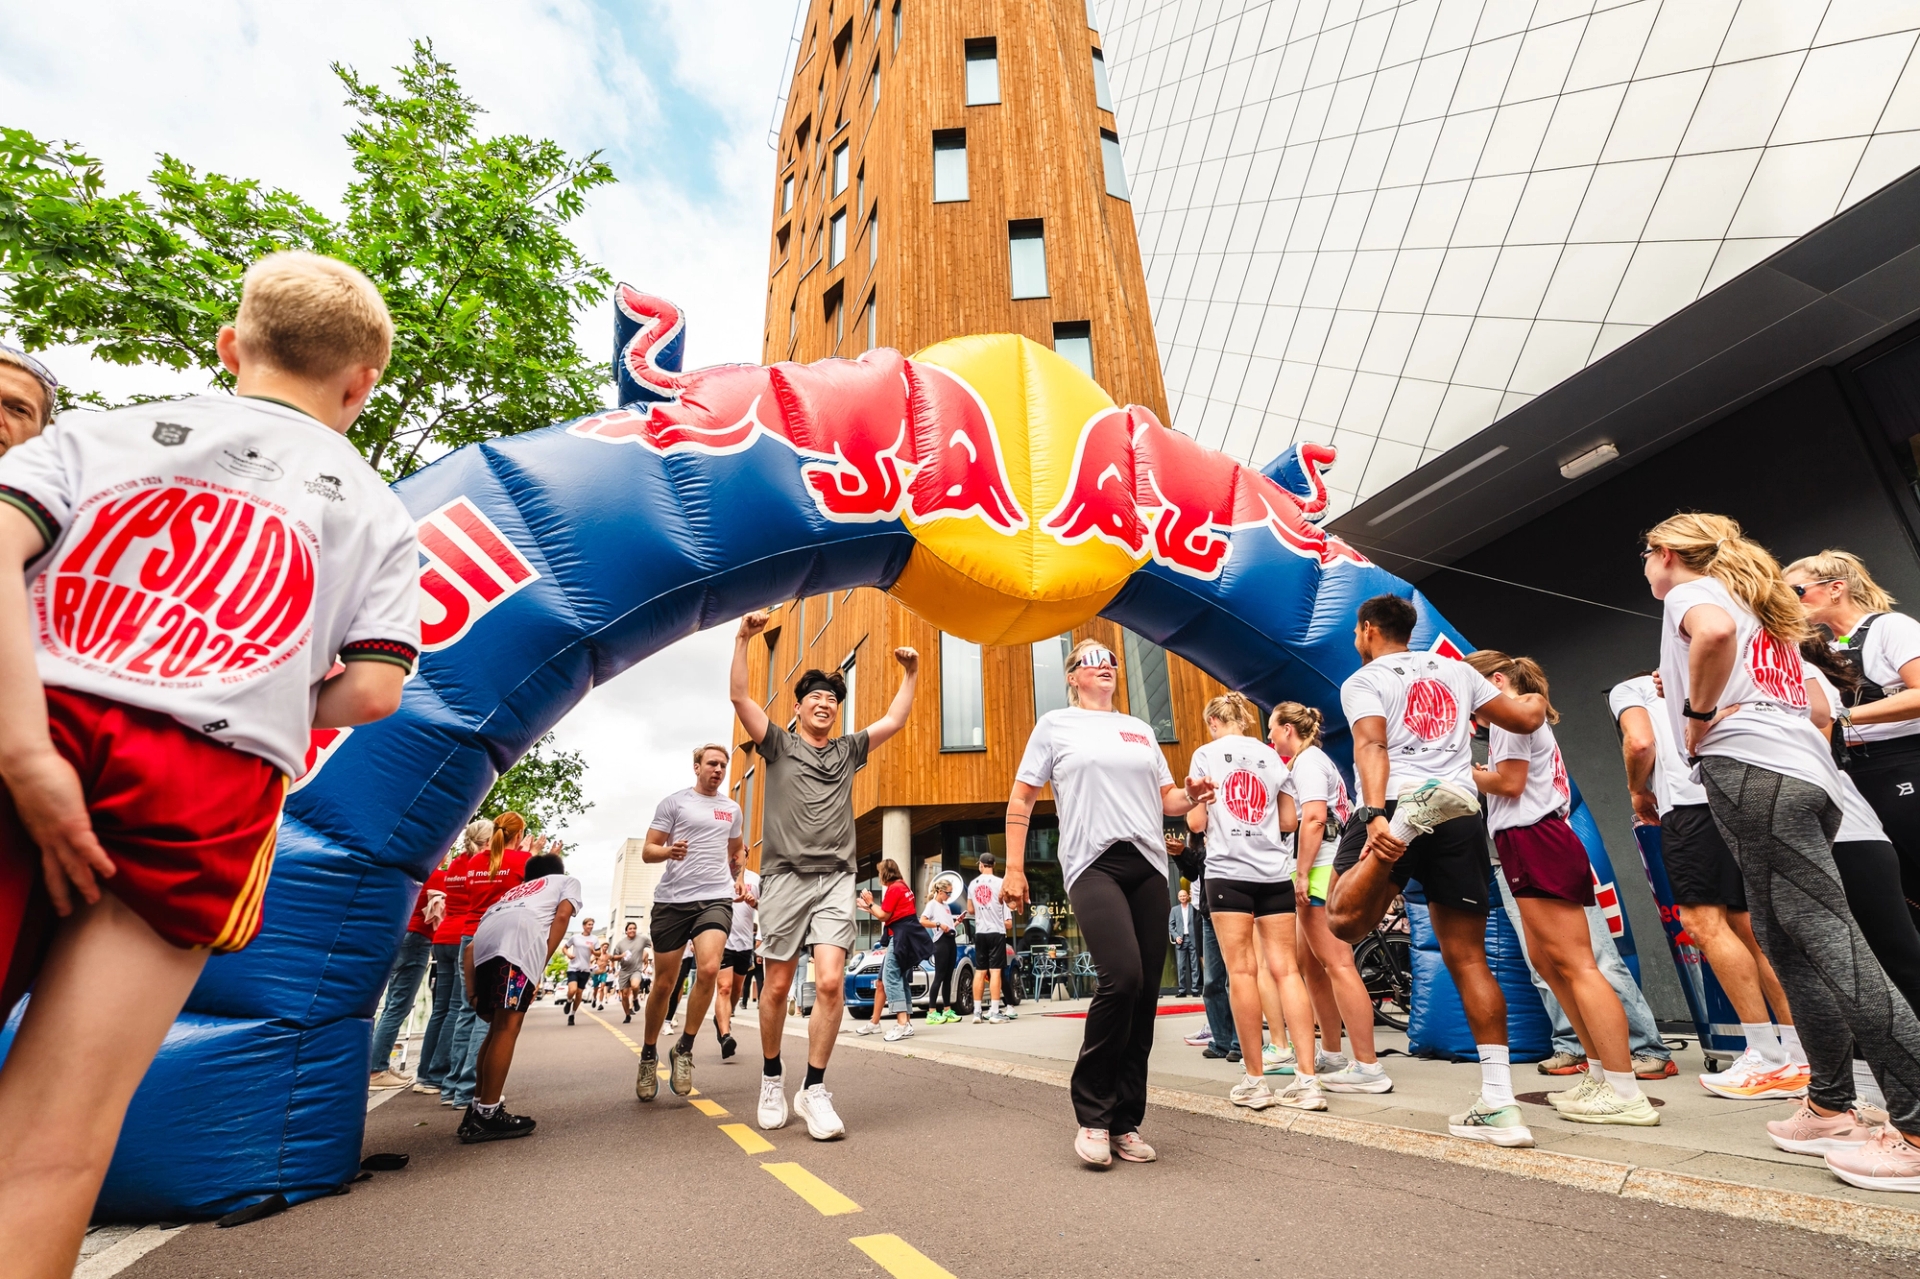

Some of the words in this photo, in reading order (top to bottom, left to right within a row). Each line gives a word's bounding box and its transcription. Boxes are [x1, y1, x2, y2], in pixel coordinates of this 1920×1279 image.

[59, 486, 315, 648] YPSILON
[417, 502, 532, 646] ull
[53, 575, 163, 665] RUN
[125, 604, 271, 679] 2026
[1754, 666, 1790, 702] RUN
[1784, 676, 1808, 706] 202
[1030, 904, 1074, 917] SOCIAL
